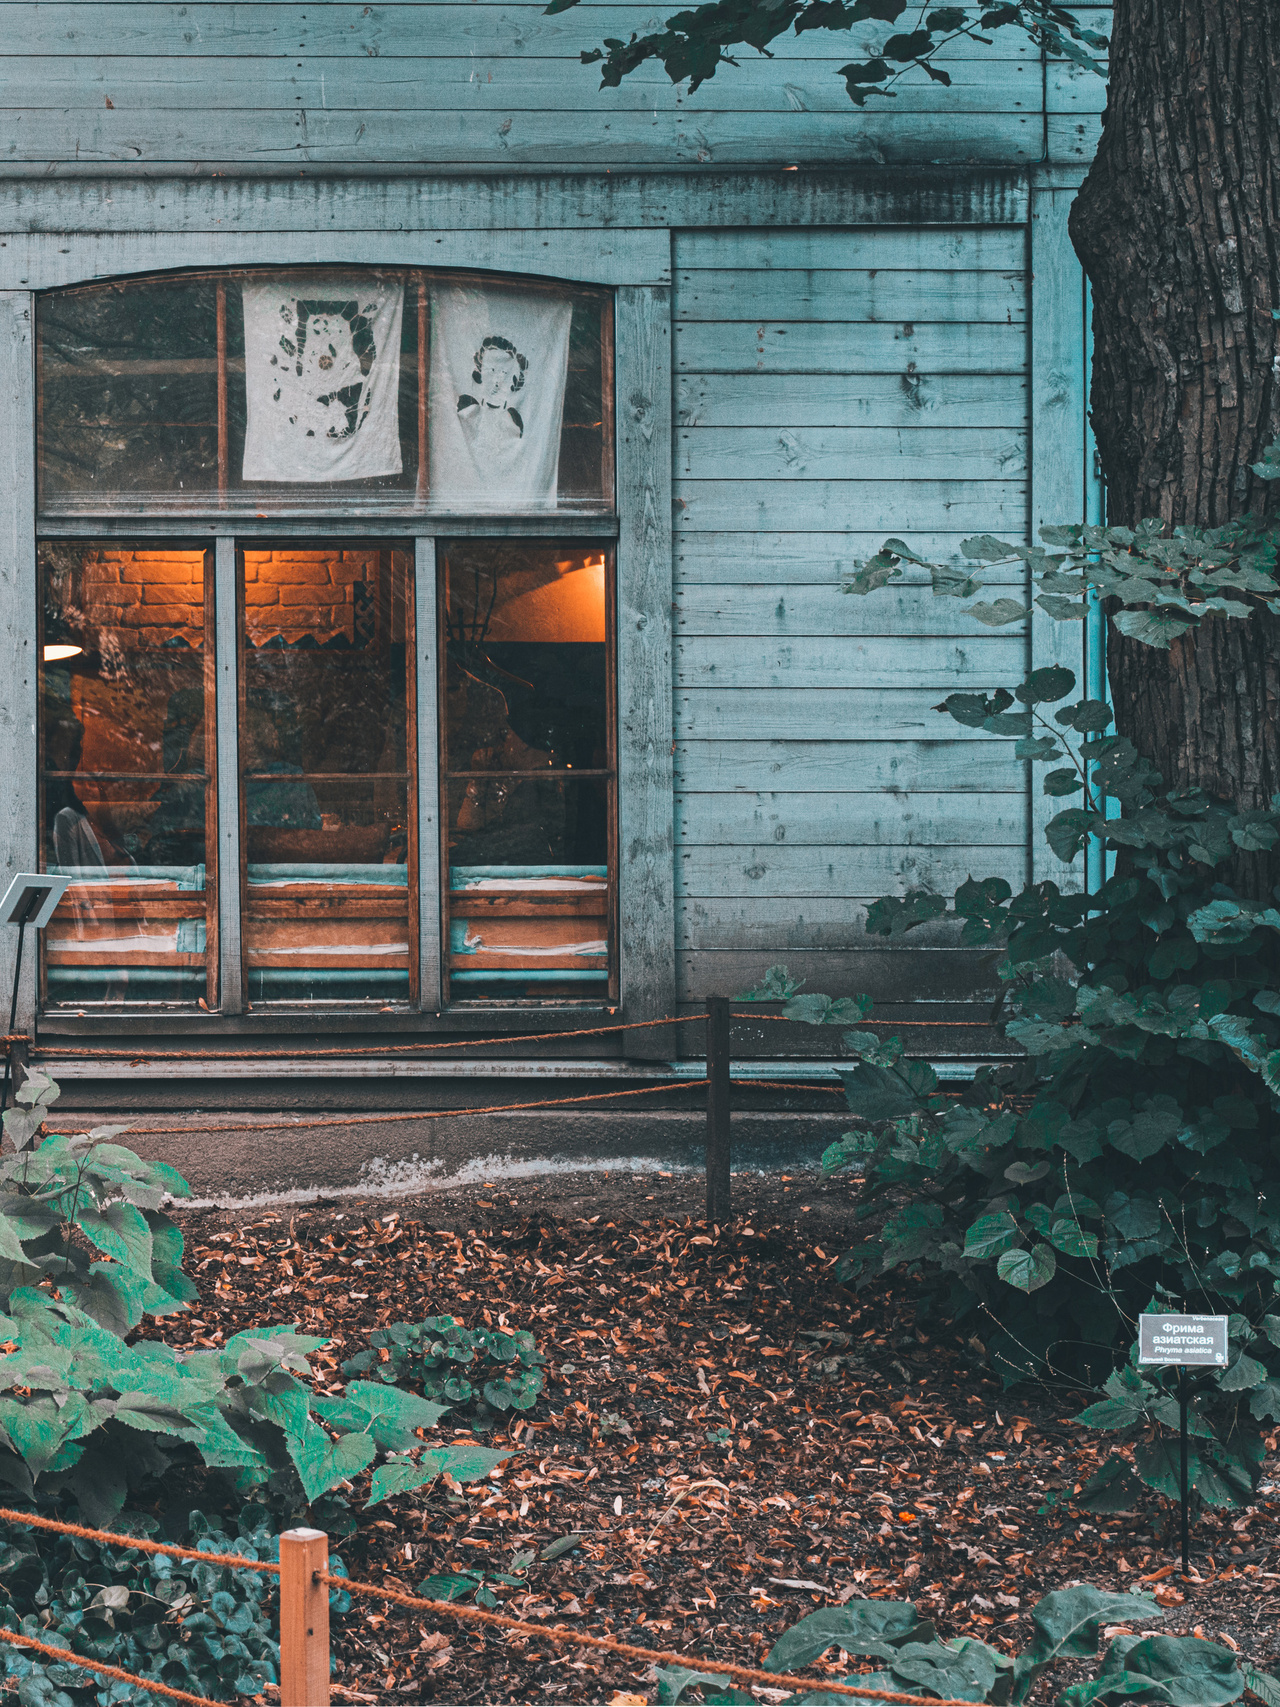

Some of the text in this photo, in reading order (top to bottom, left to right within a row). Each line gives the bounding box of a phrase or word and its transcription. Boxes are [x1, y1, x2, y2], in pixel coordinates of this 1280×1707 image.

[1162, 1323, 1204, 1335] Фрима
[1153, 1336, 1214, 1344] азиатская
[1154, 1346, 1183, 1354] Phryma
